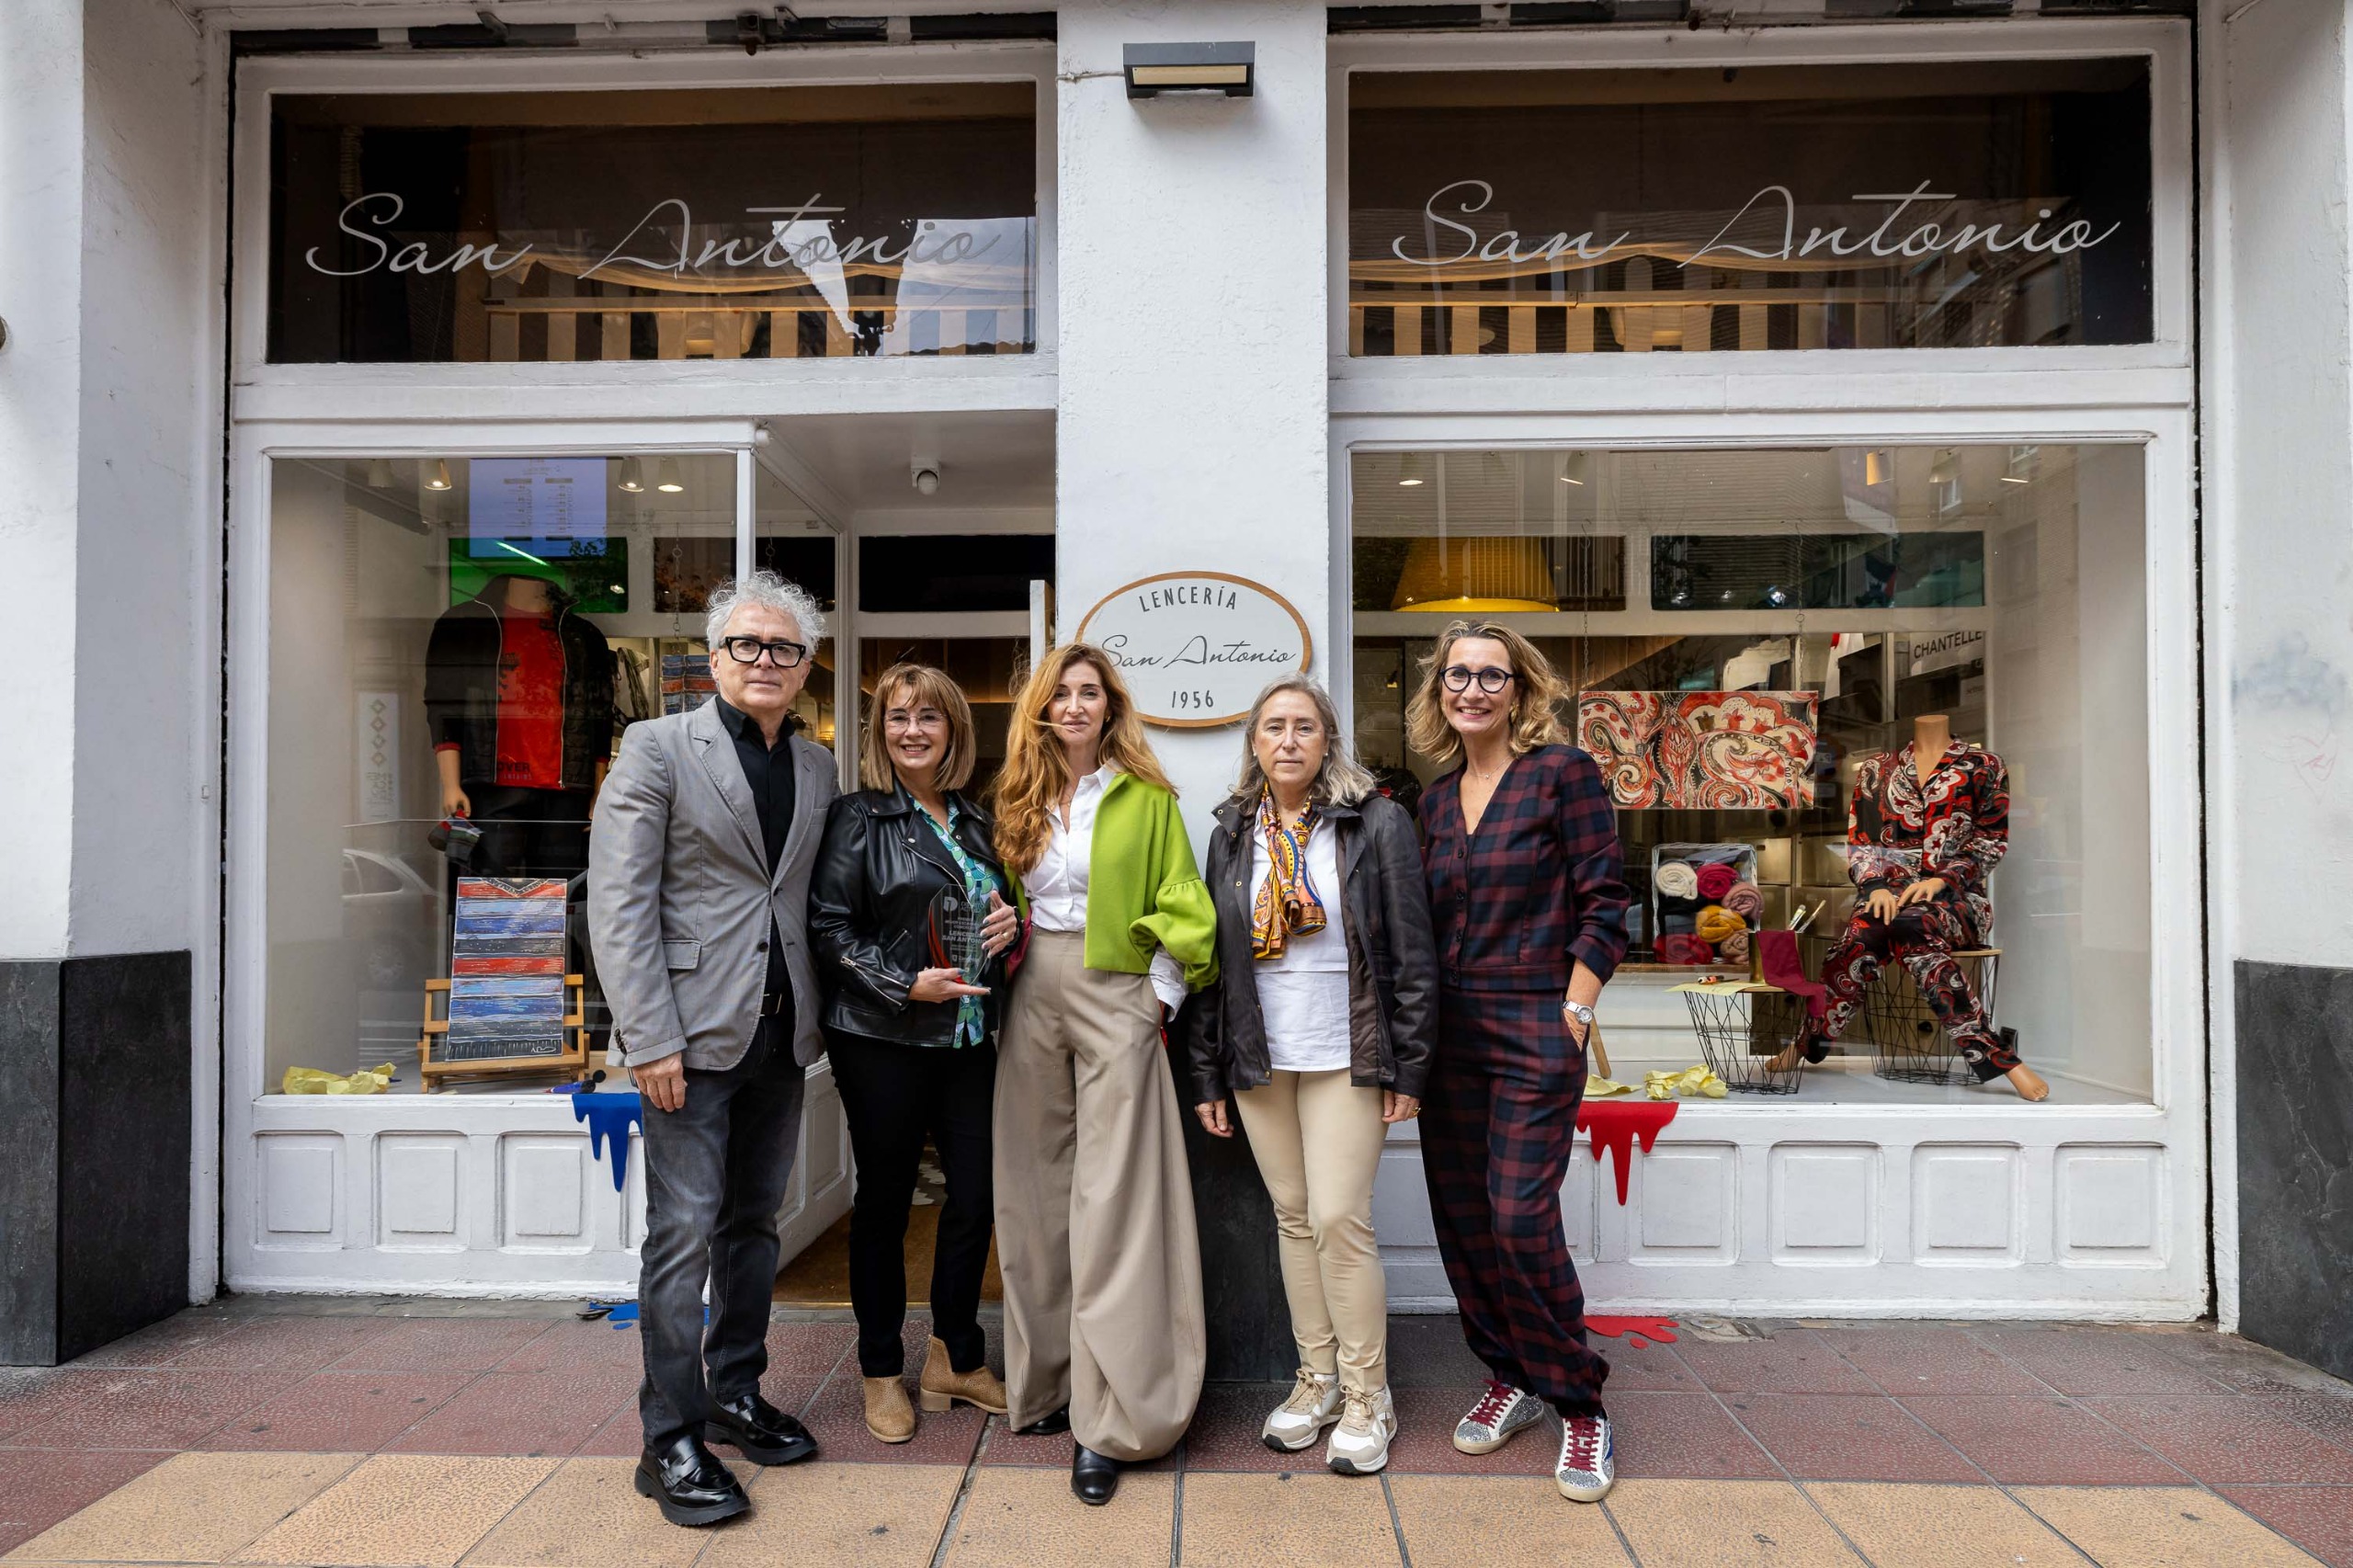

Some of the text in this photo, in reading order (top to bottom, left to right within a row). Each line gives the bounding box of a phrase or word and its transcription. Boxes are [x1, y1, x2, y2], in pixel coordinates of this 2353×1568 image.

[305, 192, 1002, 280] San Antonio
[1392, 179, 2120, 268] San Antonio
[1139, 585, 1237, 613] LENCERÍA
[1101, 634, 1297, 669] San Antonio
[1914, 631, 1983, 659] CHANTELLE
[1171, 689, 1214, 709] 1956
